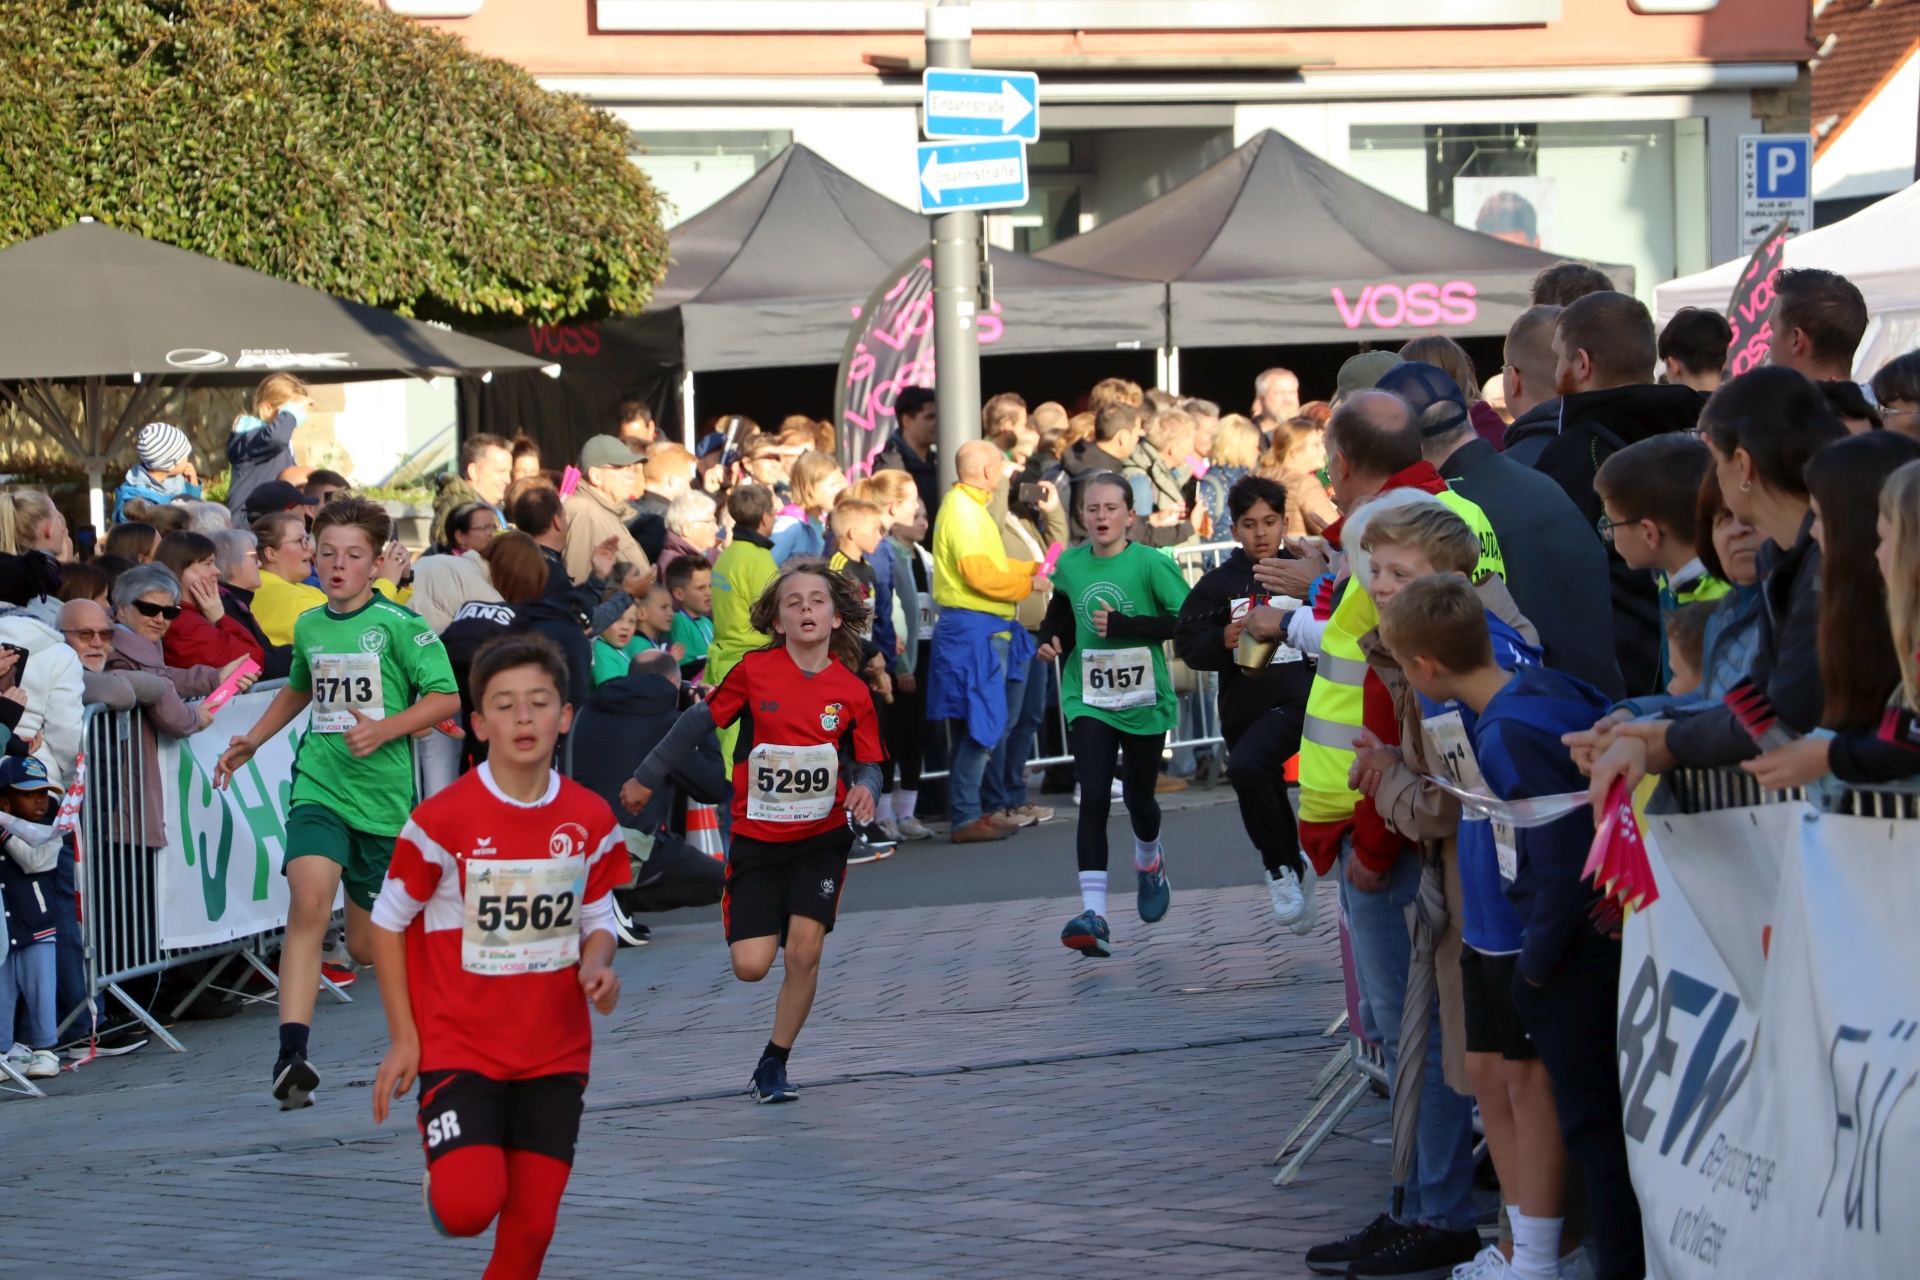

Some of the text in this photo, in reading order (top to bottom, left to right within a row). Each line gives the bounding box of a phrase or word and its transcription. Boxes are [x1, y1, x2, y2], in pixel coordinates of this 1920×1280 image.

[932, 96, 1005, 113] Einbahnstraße
[937, 165, 1015, 183] Einbahnstraße
[1746, 142, 1754, 198] PRIVAT
[1768, 147, 1796, 193] P
[1331, 281, 1477, 329] VOSS
[453, 603, 516, 626] VANS
[316, 677, 373, 703] 5713
[1089, 665, 1145, 689] 6157
[757, 767, 830, 794] 5299
[773, 812, 793, 820] VOSS
[477, 891, 574, 932] 5562
[499, 961, 526, 971] VOSS
[528, 960, 548, 970] BEW
[1617, 955, 1761, 1166] BEW
[427, 1110, 461, 1147] SR
